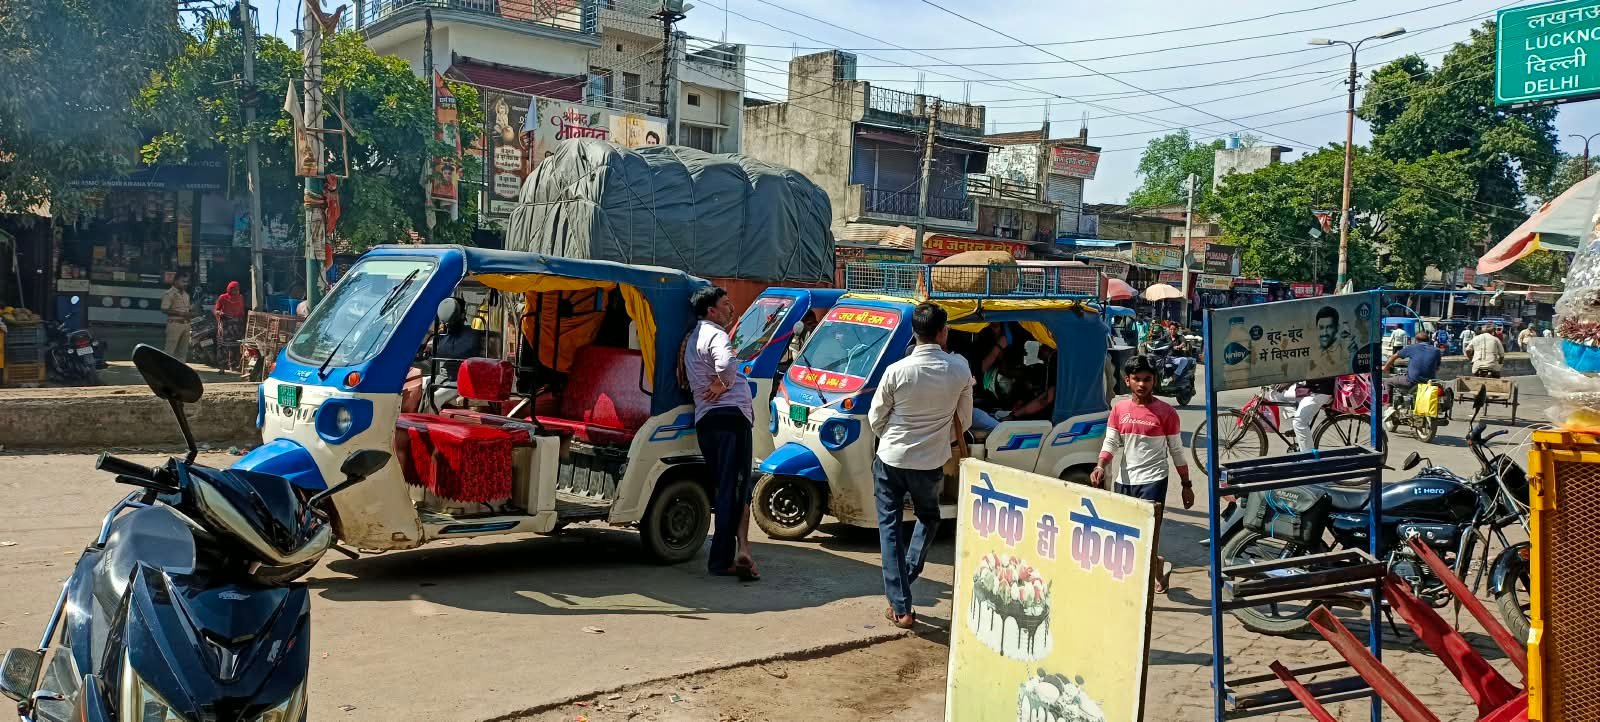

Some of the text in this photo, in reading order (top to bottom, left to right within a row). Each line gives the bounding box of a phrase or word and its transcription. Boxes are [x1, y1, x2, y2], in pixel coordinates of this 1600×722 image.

[1525, 26, 1600, 51] LUCKNO
[1525, 47, 1587, 74] दिल्ली
[1524, 74, 1579, 95] DELHI
[838, 311, 886, 325] जय श्री राम
[1259, 346, 1310, 361] में विश्वास
[971, 472, 1141, 580] केक ही केक
